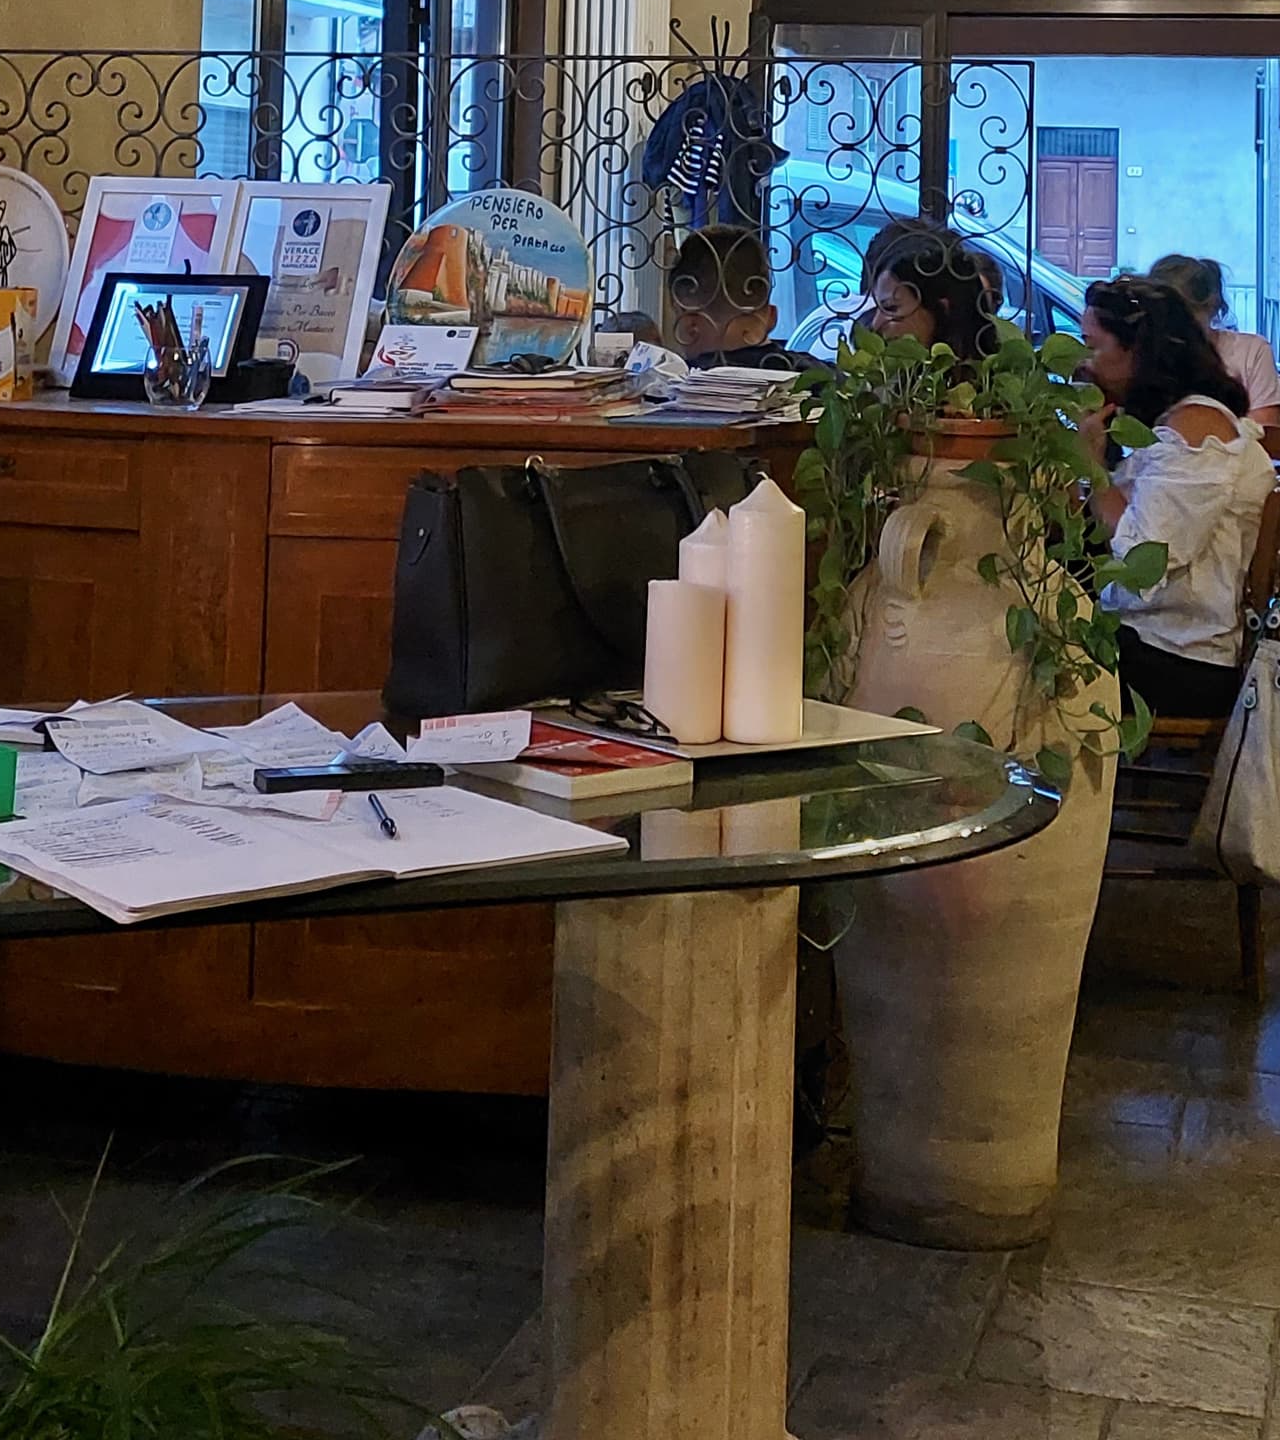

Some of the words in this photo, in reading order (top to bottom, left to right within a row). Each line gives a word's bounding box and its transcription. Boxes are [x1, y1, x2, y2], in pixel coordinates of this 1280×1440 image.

[470, 195, 544, 220] PENSIERO
[491, 214, 519, 230] PER
[284, 247, 320, 255] VERACE
[282, 255, 318, 263] PIZZA
